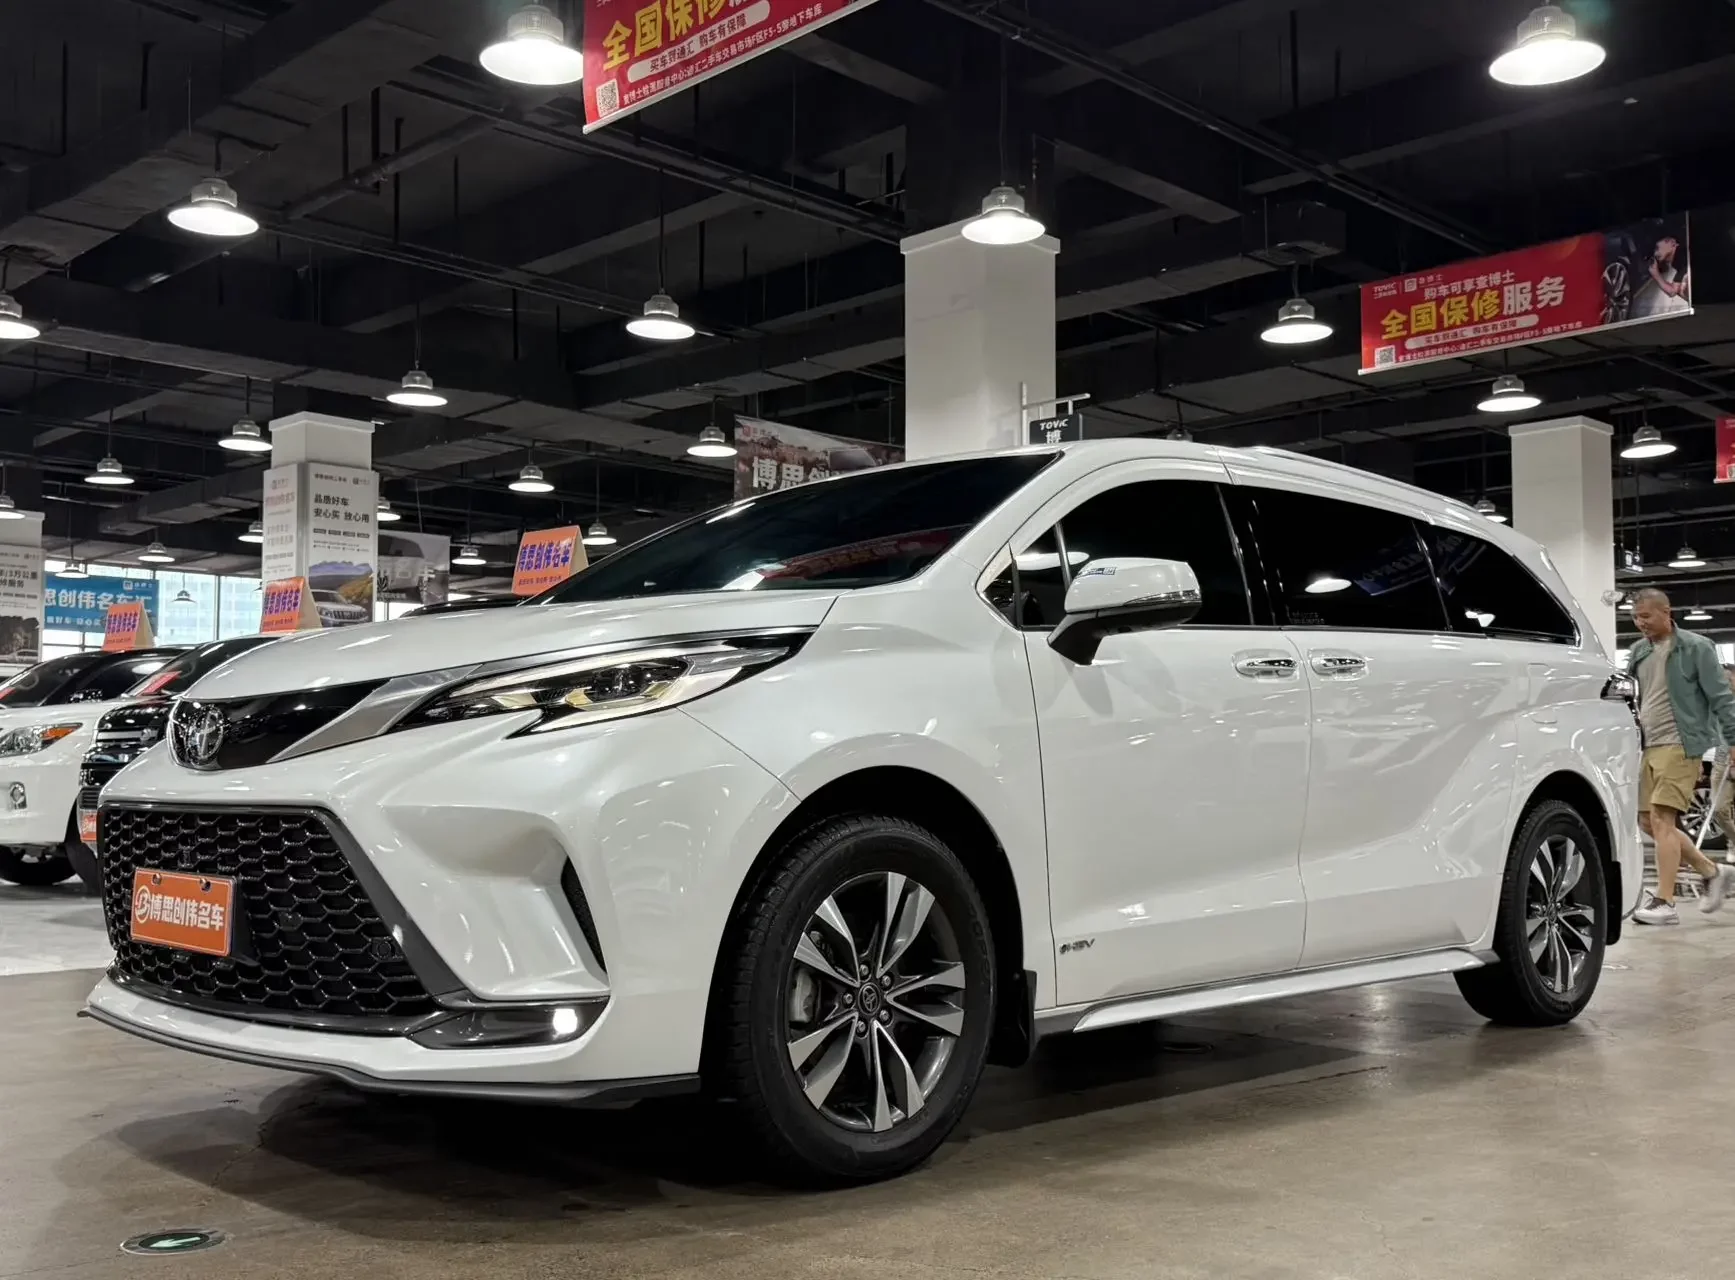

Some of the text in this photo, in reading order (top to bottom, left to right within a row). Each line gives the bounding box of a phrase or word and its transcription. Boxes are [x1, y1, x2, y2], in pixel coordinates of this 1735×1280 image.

[699, 13, 747, 48] 购车有保障
[1424, 268, 1515, 300] 购车可享查博士
[1380, 276, 1566, 340] 全国保修服务
[1040, 418, 1069, 431] TOVIC
[313, 507, 371, 524] 安心买 放心用
[314, 493, 350, 507] 品质好车
[149, 893, 225, 932] 博思创伟名车
